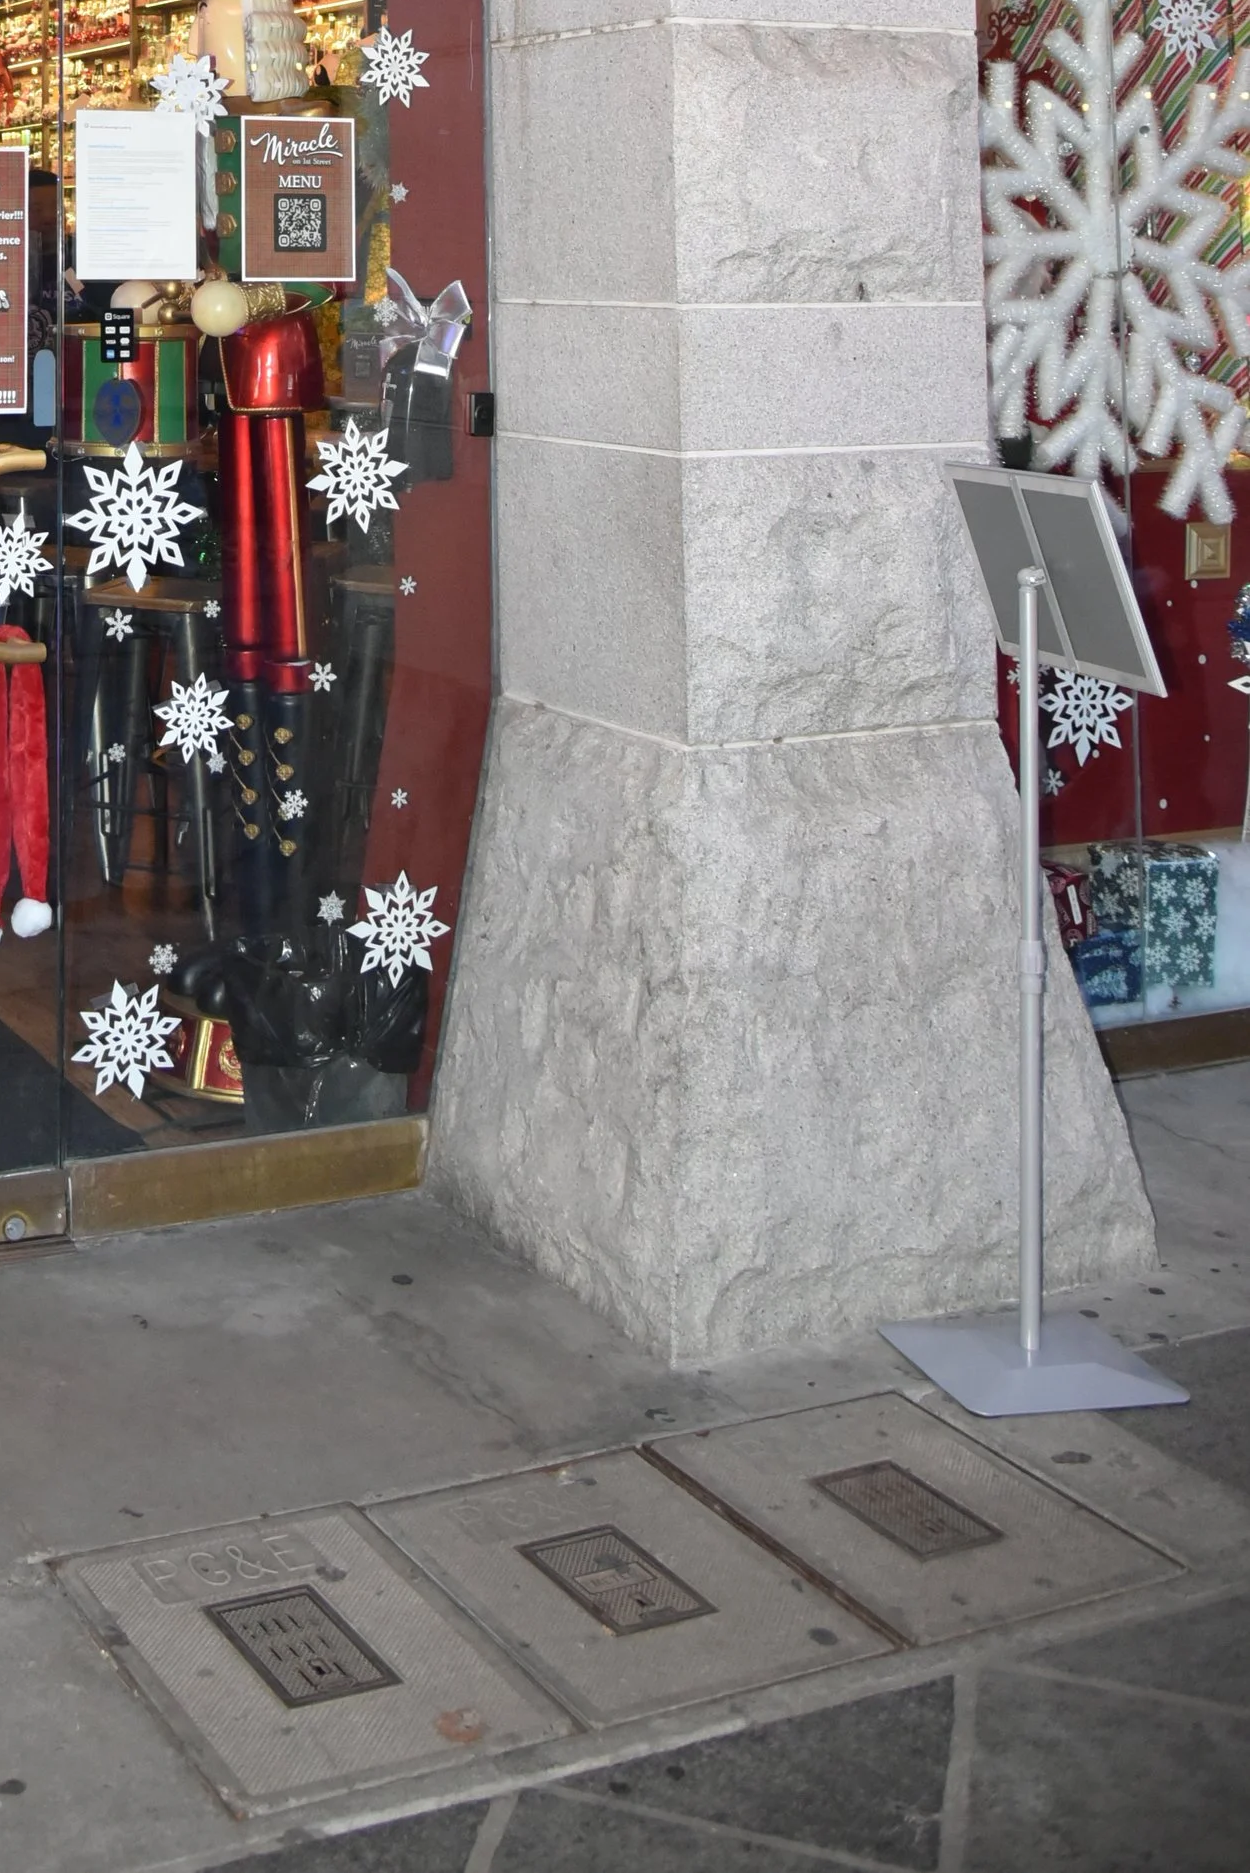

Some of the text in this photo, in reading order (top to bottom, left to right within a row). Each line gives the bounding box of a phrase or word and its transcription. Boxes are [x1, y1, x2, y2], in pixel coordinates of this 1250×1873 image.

[250, 122, 338, 165] Miracle
[278, 175, 322, 188] MENU
[142, 1533, 316, 1593] PG&E
